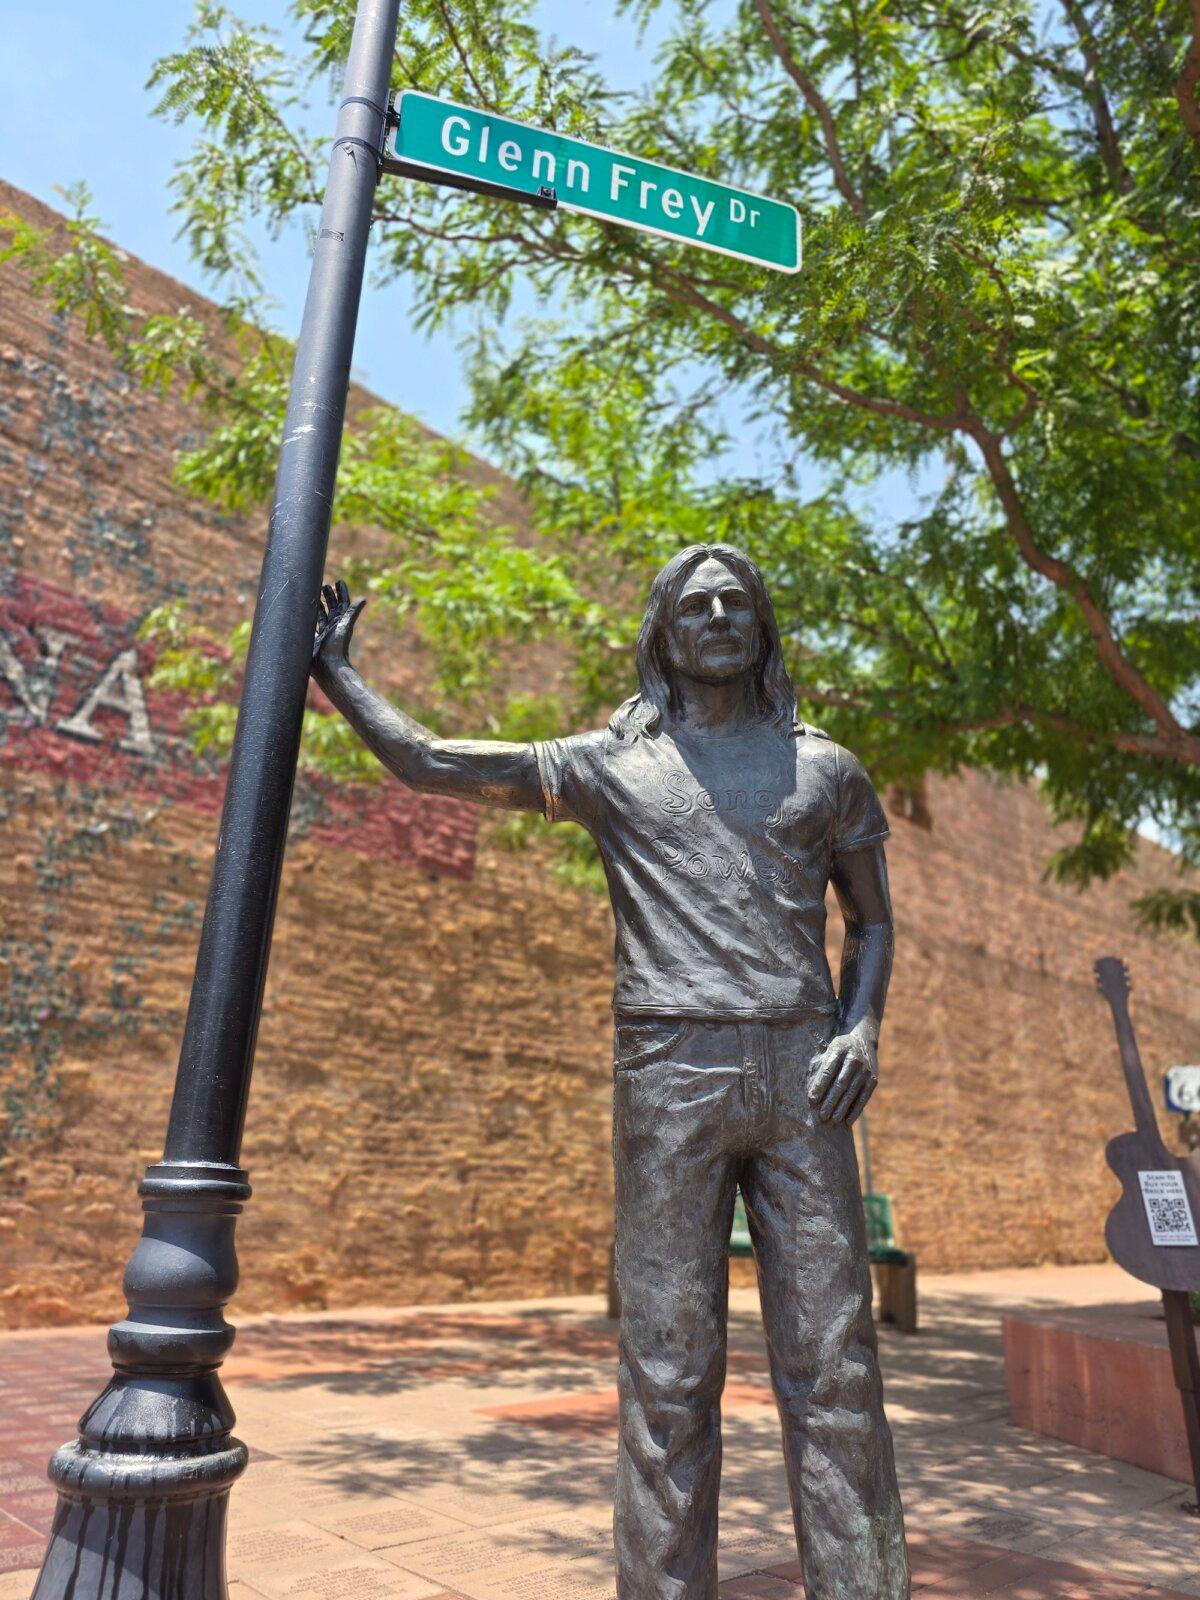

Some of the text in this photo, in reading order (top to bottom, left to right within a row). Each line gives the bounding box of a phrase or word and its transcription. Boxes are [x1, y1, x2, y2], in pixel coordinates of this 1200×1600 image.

[441, 115, 761, 236] Glenn Frey Dr
[660, 770, 784, 828] Song
